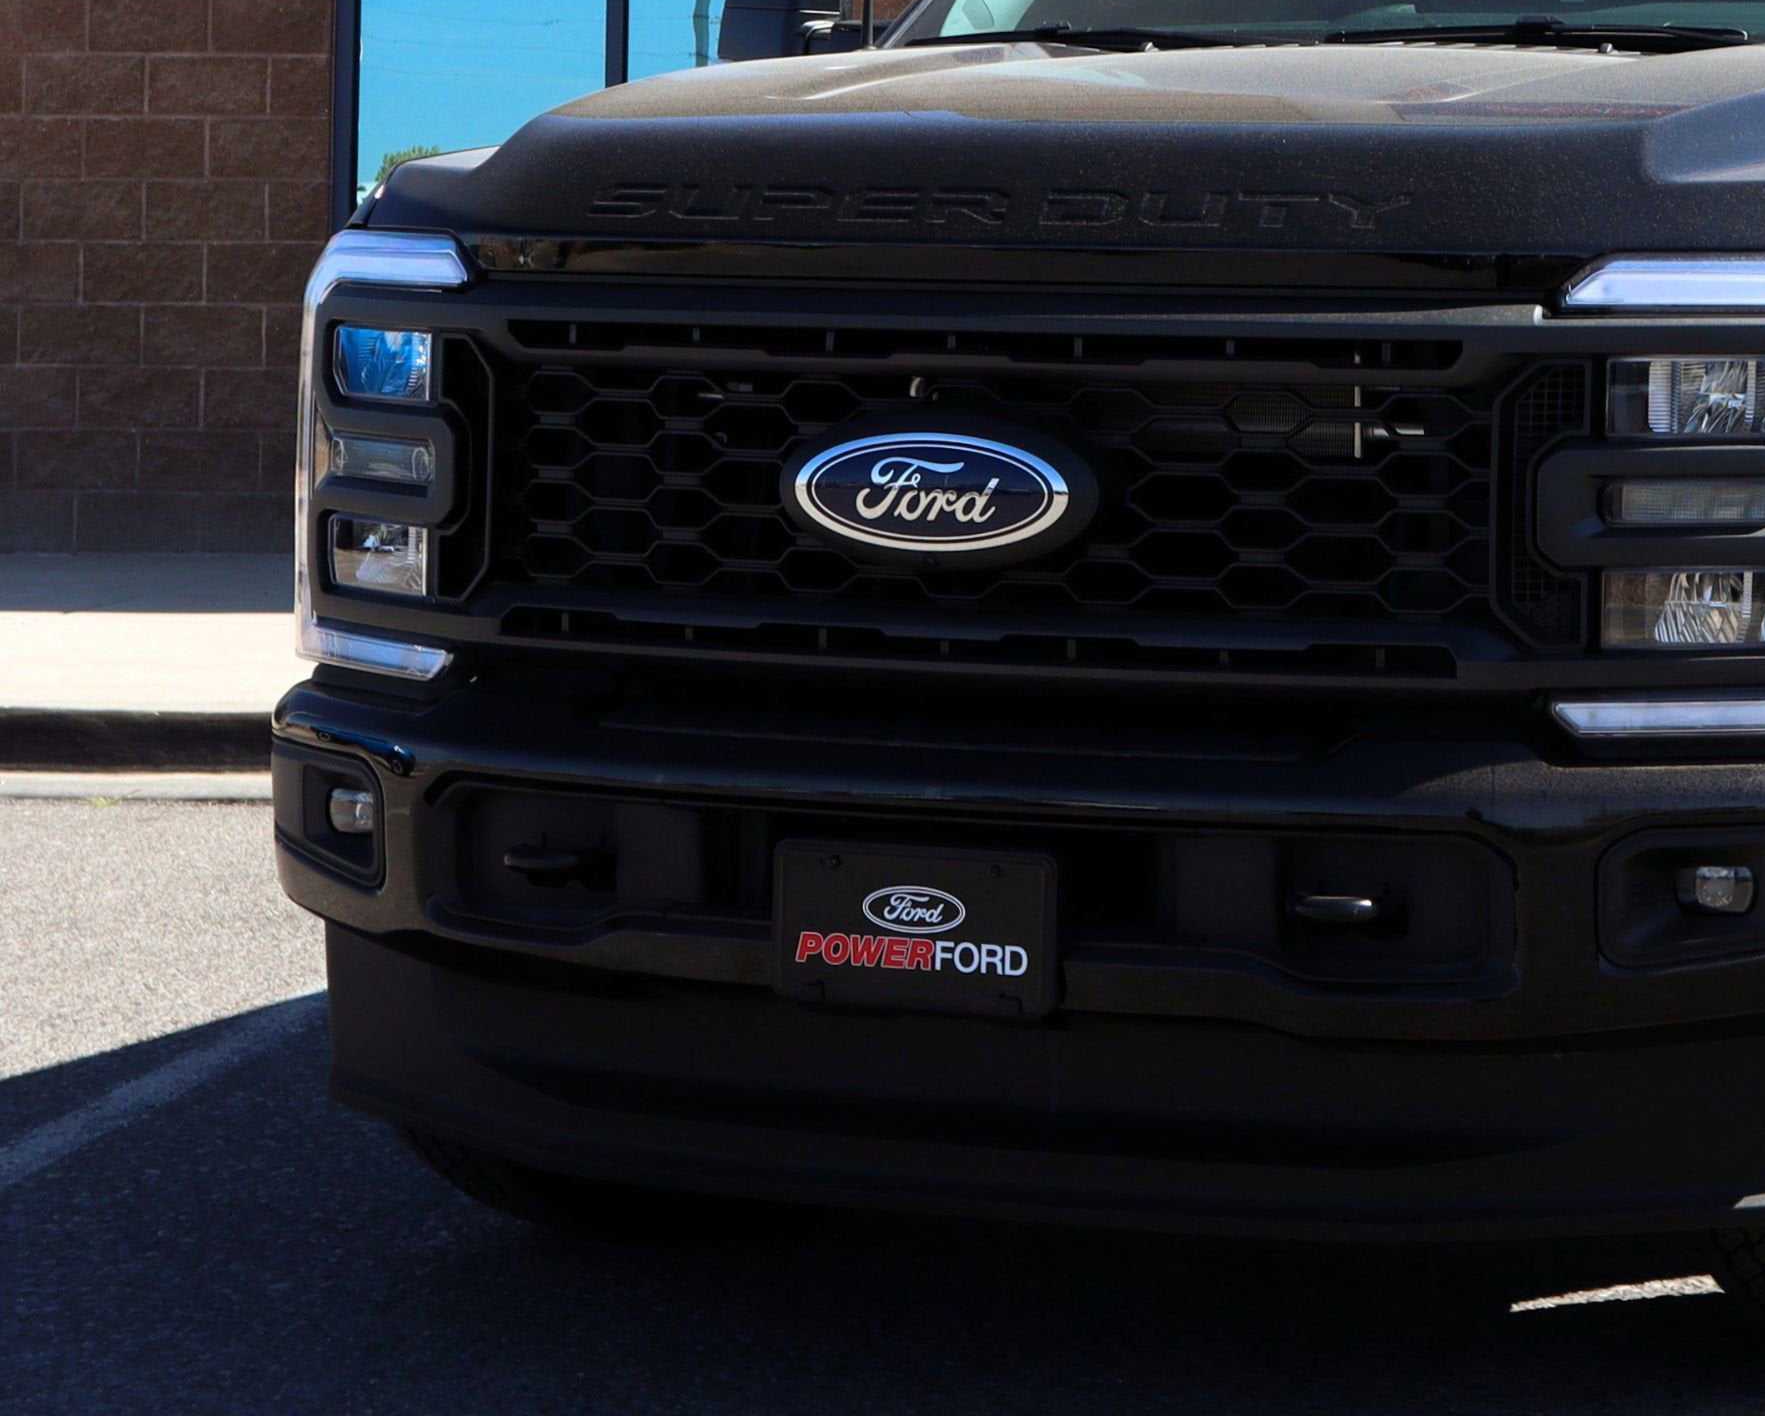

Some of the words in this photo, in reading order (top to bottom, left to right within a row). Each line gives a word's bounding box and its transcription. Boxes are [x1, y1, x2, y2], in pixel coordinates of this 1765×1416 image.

[586, 186, 1008, 224] SUPER
[1036, 189, 1412, 230] DUTY
[856, 456, 1000, 523] Ford
[883, 893, 944, 924] Ford
